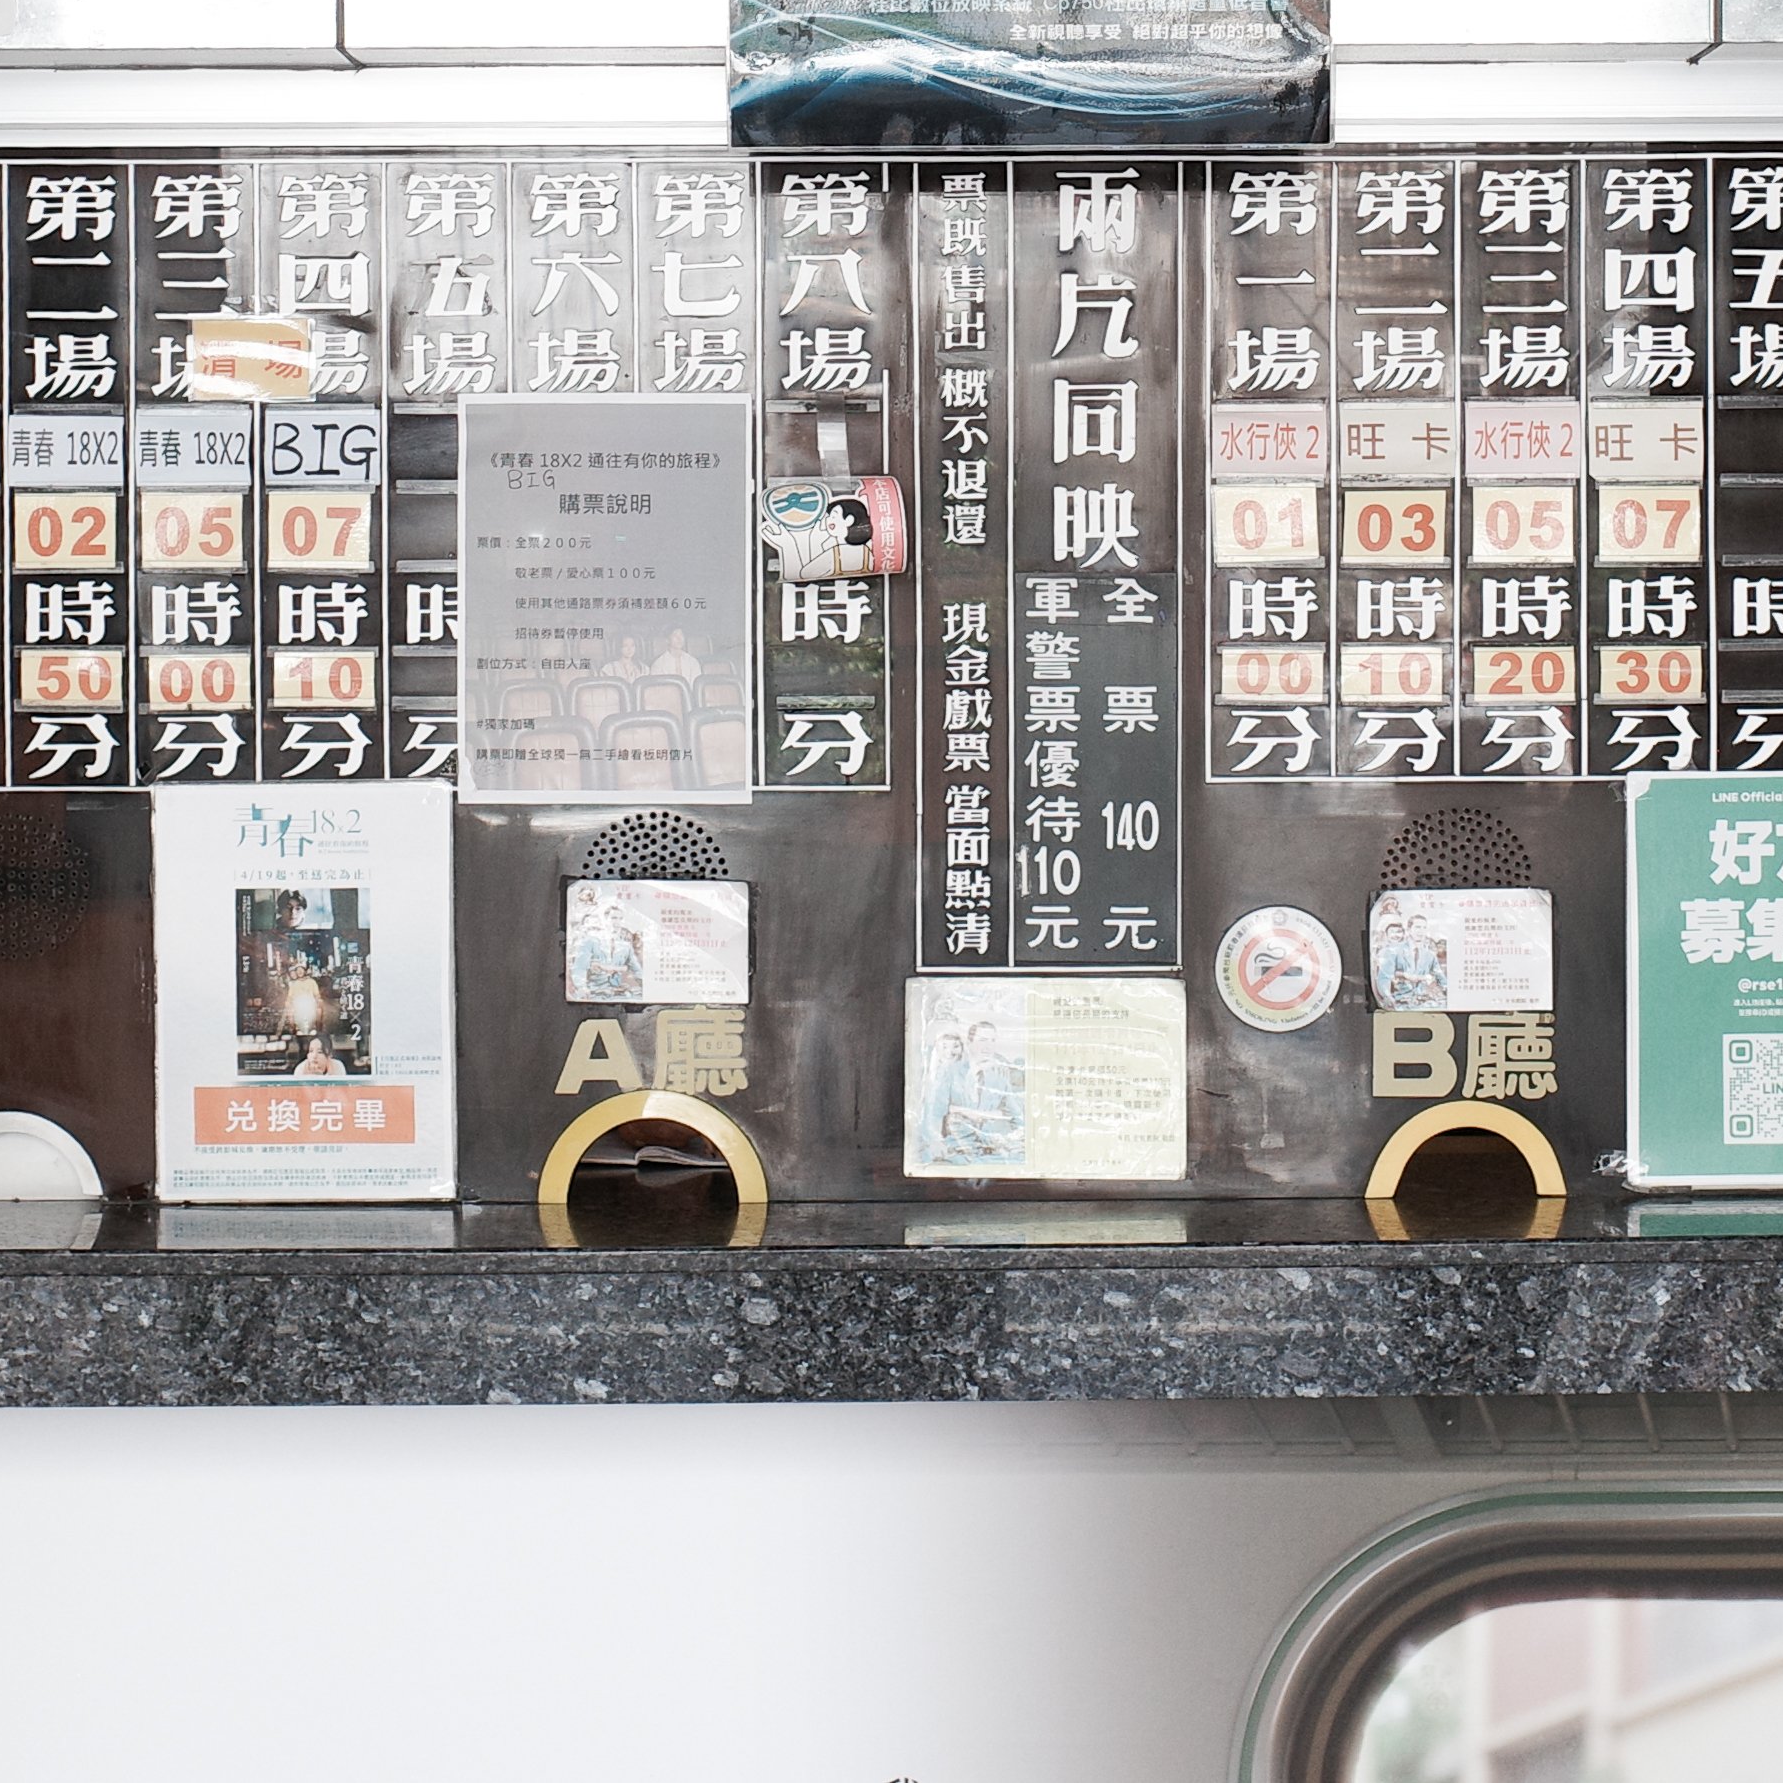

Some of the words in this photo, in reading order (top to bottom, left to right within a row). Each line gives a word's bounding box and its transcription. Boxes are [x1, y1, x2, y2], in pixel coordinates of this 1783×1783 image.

[1009, 23, 1121, 41] 全新視聽享受
[1132, 23, 1282, 41] 絕對超乎你的想像
[402, 171, 497, 396] 第五場
[527, 170, 622, 393] 第六場
[651, 170, 747, 393] 第七場
[779, 170, 874, 391] 第八場
[941, 171, 988, 352] 票既售出
[1228, 169, 1321, 392] 第一場
[1353, 169, 1449, 392] 第二場
[1477, 168, 1570, 390] 第三場
[1602, 168, 1697, 390] 第四場
[23, 175, 118, 401] 第二場
[1052, 166, 1141, 571] 兩片同映
[11, 428, 55, 468] 青春
[67, 431, 119, 467] 18X2
[138, 428, 182, 469] 青春
[194, 430, 246, 467] 18X2
[273, 423, 377, 484] BIG
[489, 453, 535, 468] 《青春
[540, 453, 583, 468] 18X2
[588, 452, 722, 468] 通往有你的旅程》
[940, 368, 990, 547] 概不退還
[1346, 422, 1452, 463] 旺卡
[1594, 422, 1700, 463] 旺卡
[507, 470, 556, 490] BIG
[559, 494, 652, 515] 購票說明
[27, 507, 108, 557] 02
[155, 507, 234, 557] 05
[282, 507, 363, 557] 07
[1231, 498, 1305, 551] 01
[1356, 504, 1437, 553] 03
[1484, 499, 1565, 552] 05
[1612, 499, 1692, 551] 07
[36, 656, 112, 702] 50
[158, 659, 235, 703] 00
[288, 657, 363, 700] 10
[941, 602, 993, 774] 現金戲票
[1236, 652, 1314, 697] 00
[1358, 652, 1433, 697] 10
[1488, 652, 1566, 696] 20
[1616, 651, 1693, 694] 30
[1712, 792, 1739, 803] LINE
[233, 803, 314, 858] 青春
[943, 783, 993, 956] 當面點清
[554, 1005, 750, 1097] A廳
[1373, 1011, 1558, 1100] B廳
[225, 1099, 387, 1133] 兌換完畢
